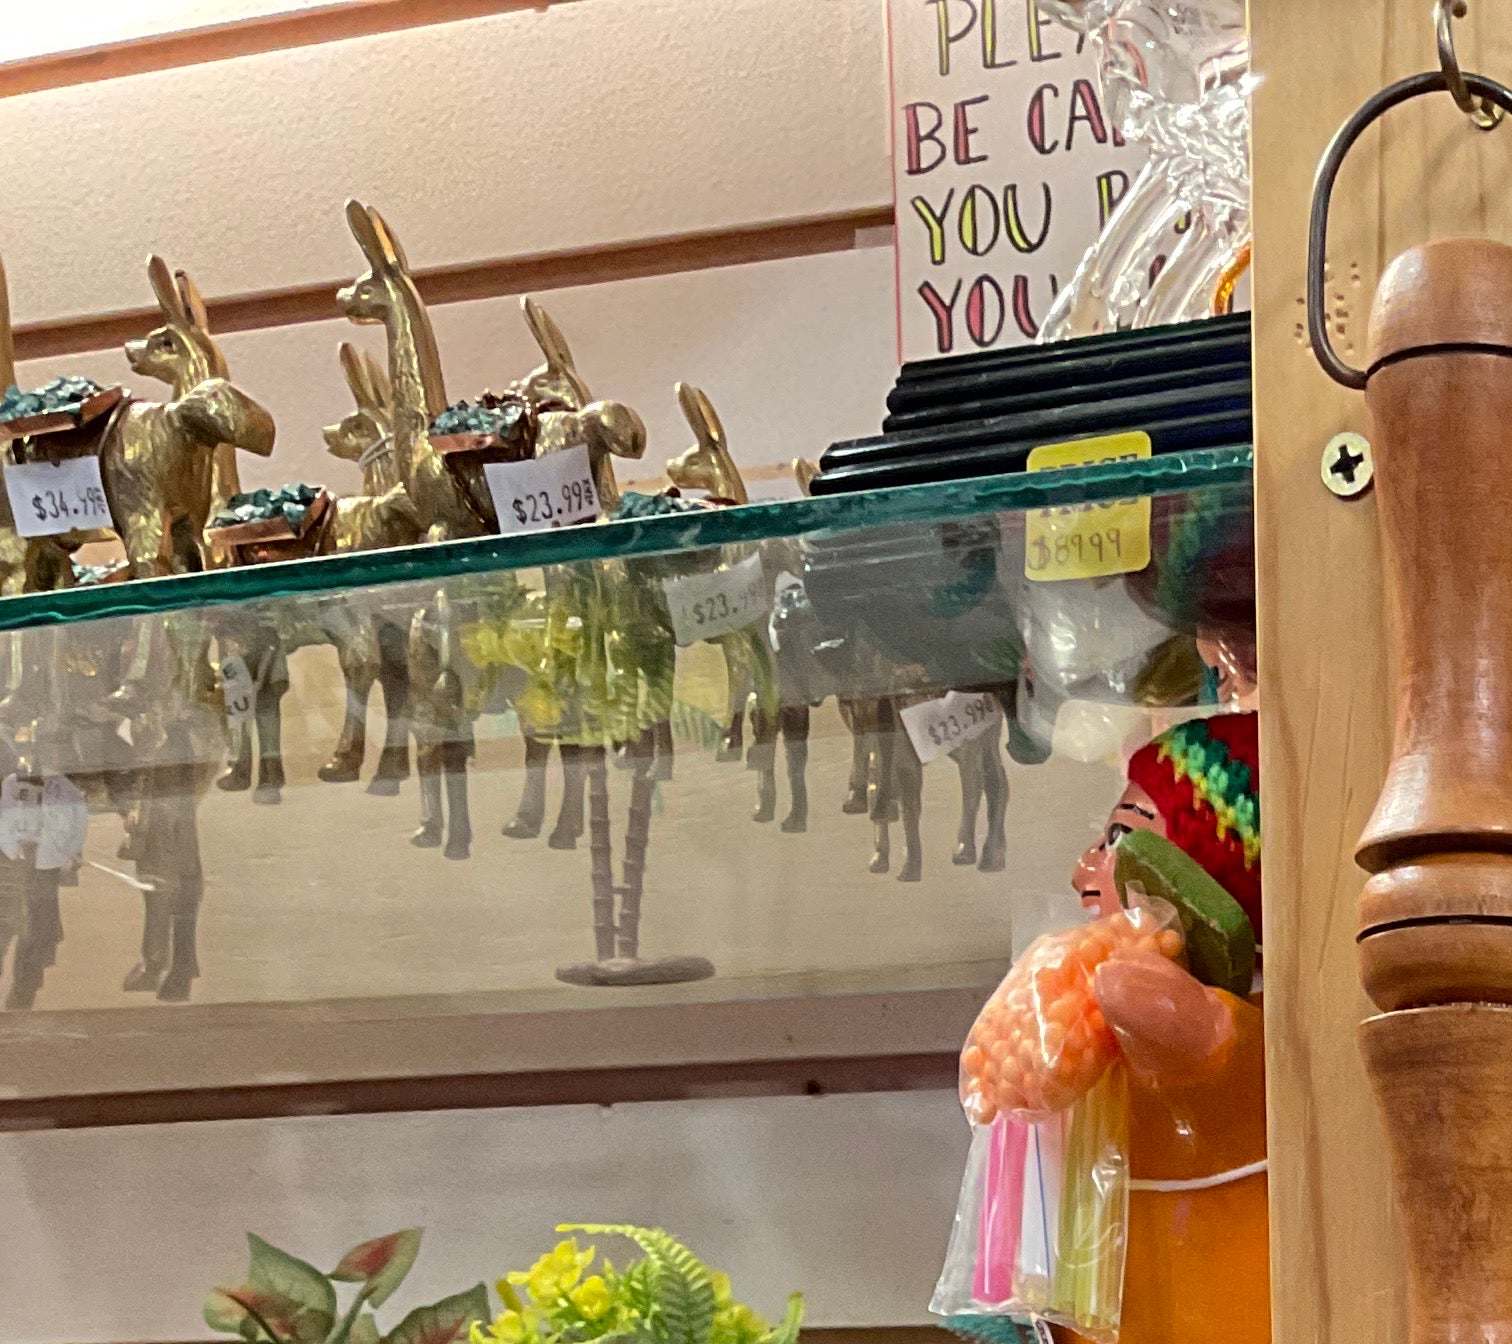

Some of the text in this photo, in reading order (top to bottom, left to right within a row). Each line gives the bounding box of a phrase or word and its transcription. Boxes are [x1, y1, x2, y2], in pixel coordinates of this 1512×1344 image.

[925, 0, 1085, 76] PLE
[903, 79, 1125, 175] BE CA
[910, 182, 1052, 265] YOU
[917, 274, 1058, 353] YOU
[511, 480, 583, 526] $23.99
